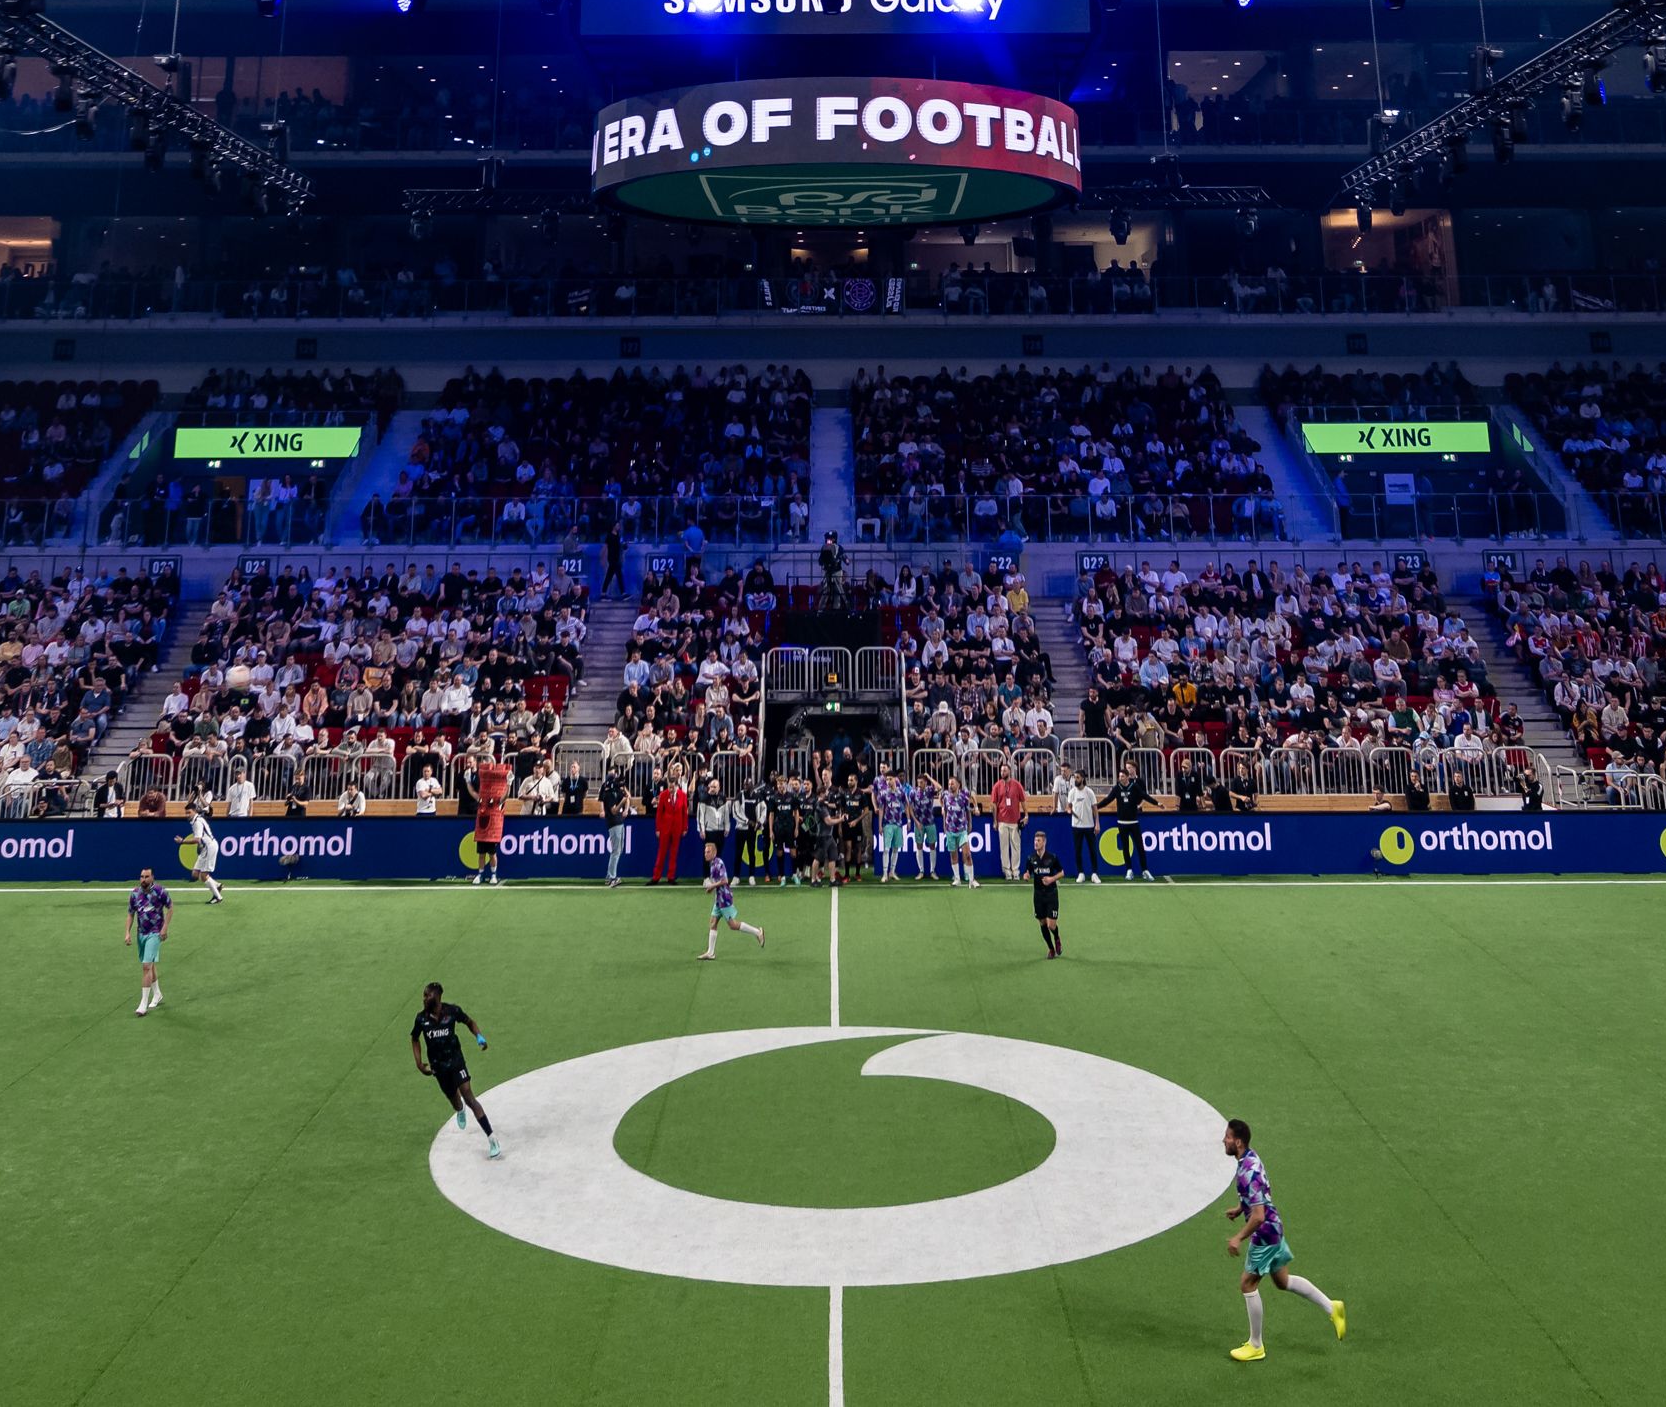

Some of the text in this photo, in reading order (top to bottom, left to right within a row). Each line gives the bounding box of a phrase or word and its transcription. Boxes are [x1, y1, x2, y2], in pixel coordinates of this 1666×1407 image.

[603, 107, 684, 166] ERA
[702, 97, 793, 146] OF
[816, 96, 1081, 172] FOOTBALL
[252, 433, 303, 453] XING
[1380, 427, 1431, 448] XING
[220, 827, 353, 857] orthomol
[1141, 823, 1272, 852] orthomol
[1420, 822, 1553, 851] orthomol
[432, 1027, 450, 1039] XING
